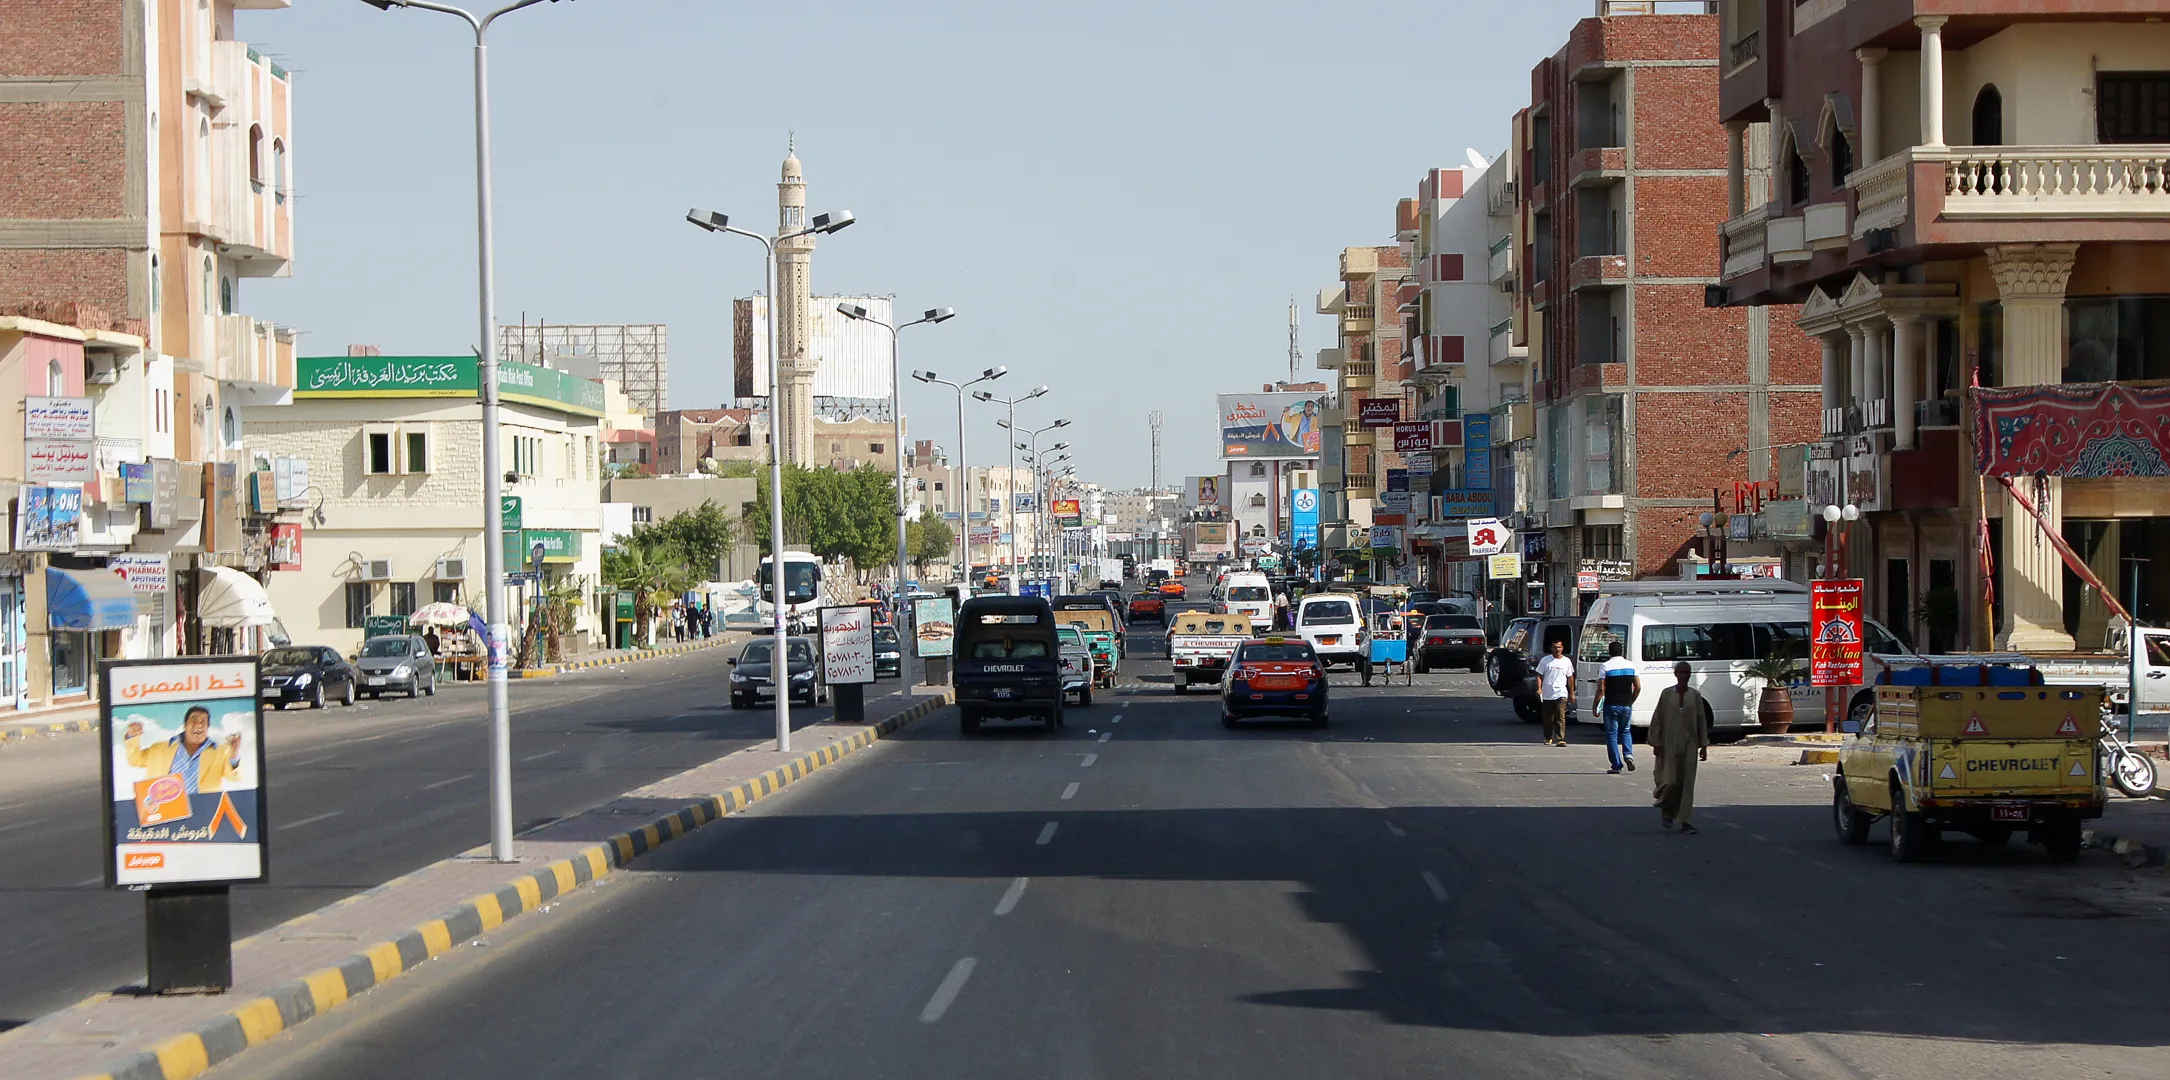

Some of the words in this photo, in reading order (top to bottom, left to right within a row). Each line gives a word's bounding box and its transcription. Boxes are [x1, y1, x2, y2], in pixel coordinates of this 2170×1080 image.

[352, 361, 395, 387] الغردقة
[425, 363, 458, 385] مكتب
[1236, 402, 1256, 410] خط
[1361, 402, 1398, 416] المختبر
[1396, 425, 1416, 433] HORUS
[1418, 424, 1429, 432] LAB
[1445, 492, 1466, 503] BABA
[1449, 505, 1489, 515] CENTER
[1471, 546, 1499, 554] PHARMACY
[128, 567, 166, 575] PHARMACY
[131, 575, 166, 583] APOTHEKE
[1815, 596, 1858, 612] الميناء
[823, 620, 861, 633] الجمهورية
[1829, 645, 1861, 659] Mina
[983, 664, 1024, 673] CHEVROLET
[1827, 661, 1860, 669] Restaurants
[121, 675, 200, 698] المصرى
[207, 673, 246, 691] خط
[1966, 758, 2060, 772] CHEVROLET
